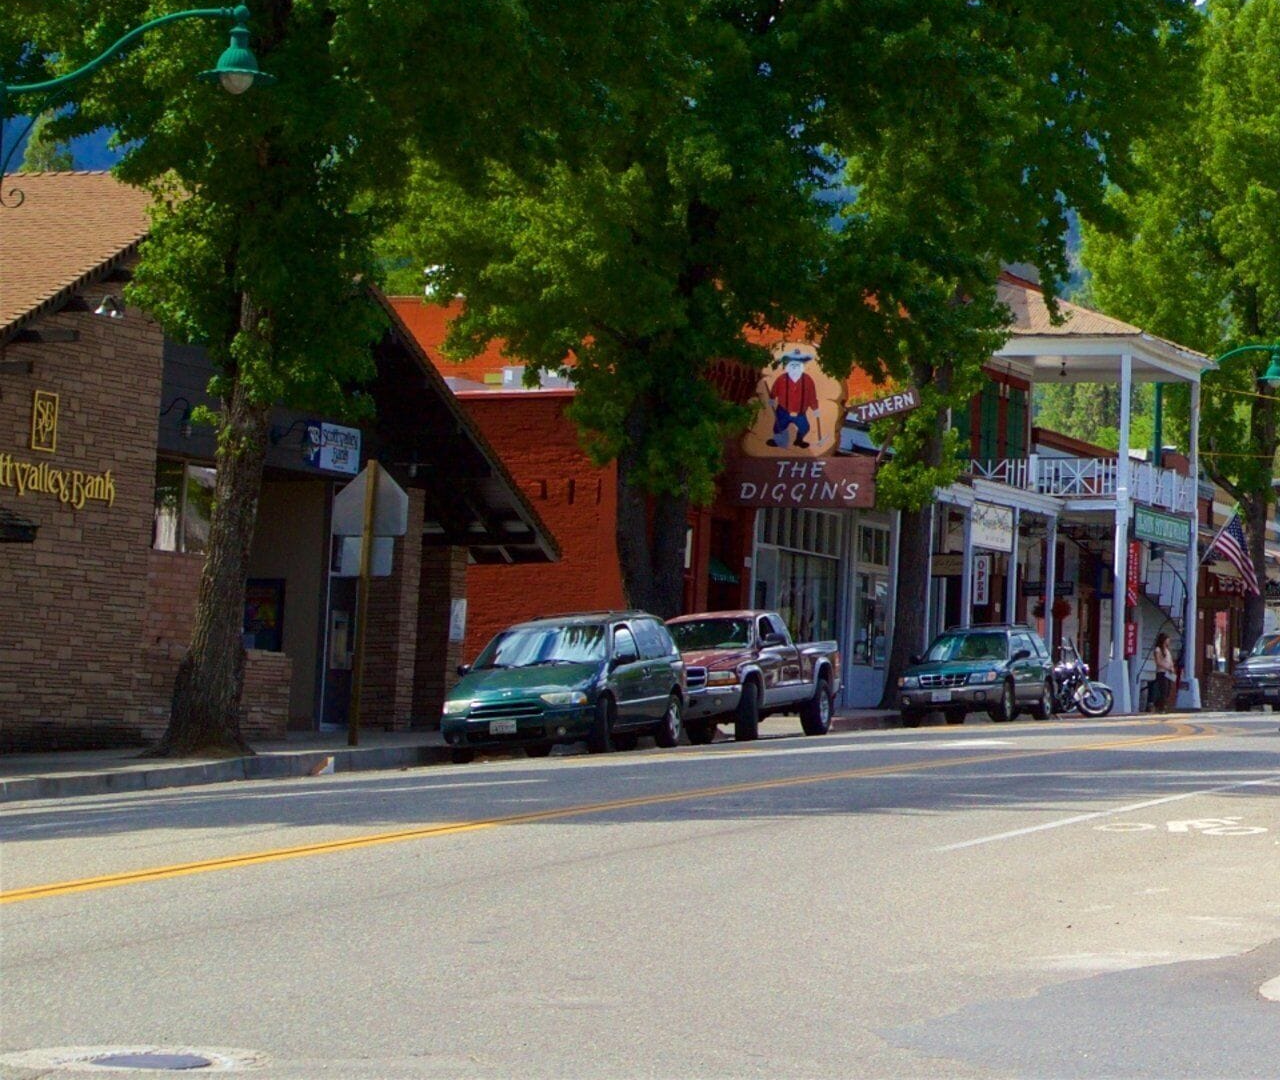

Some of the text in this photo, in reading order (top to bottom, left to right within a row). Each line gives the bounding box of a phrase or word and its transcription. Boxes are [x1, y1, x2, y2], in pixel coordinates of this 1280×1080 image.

[858, 392, 914, 420] TAVERN
[777, 461, 826, 478] THE
[70, 469, 115, 509] Bank
[740, 479, 860, 502] DIGGIN'S
